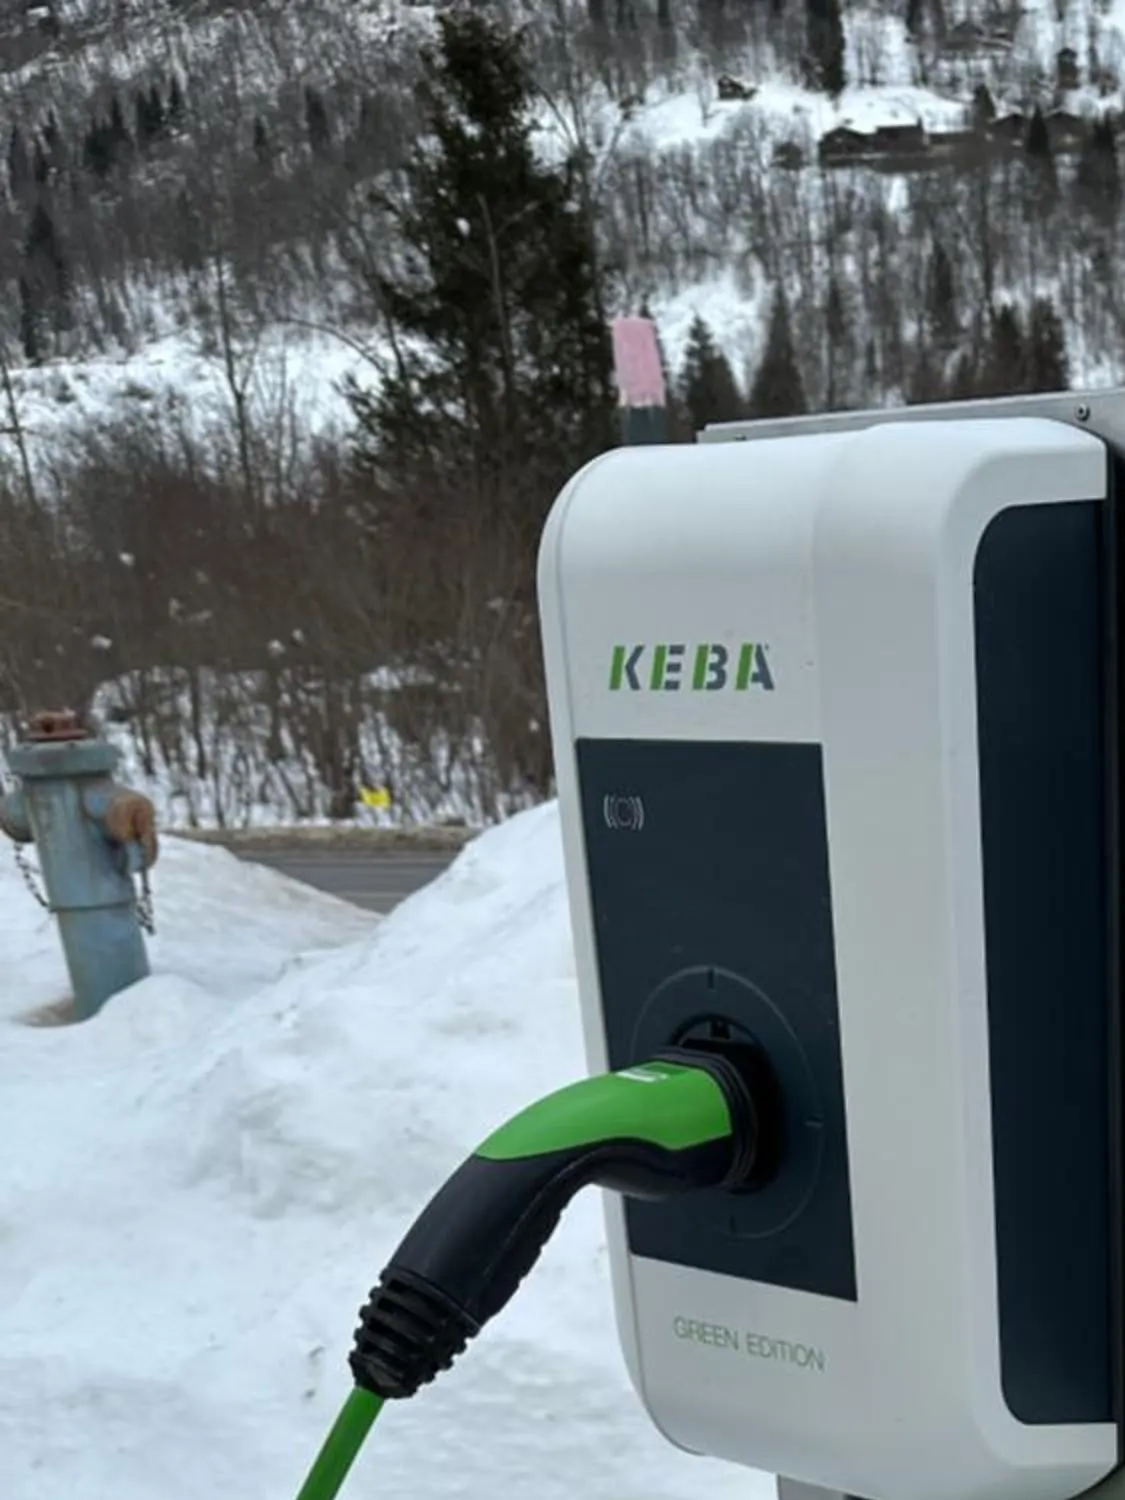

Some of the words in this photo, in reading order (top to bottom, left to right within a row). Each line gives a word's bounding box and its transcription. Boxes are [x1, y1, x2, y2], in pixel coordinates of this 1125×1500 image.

[608, 642, 775, 691] KEBA
[672, 1315, 740, 1351] GREEN
[745, 1331, 826, 1373] EDITION
